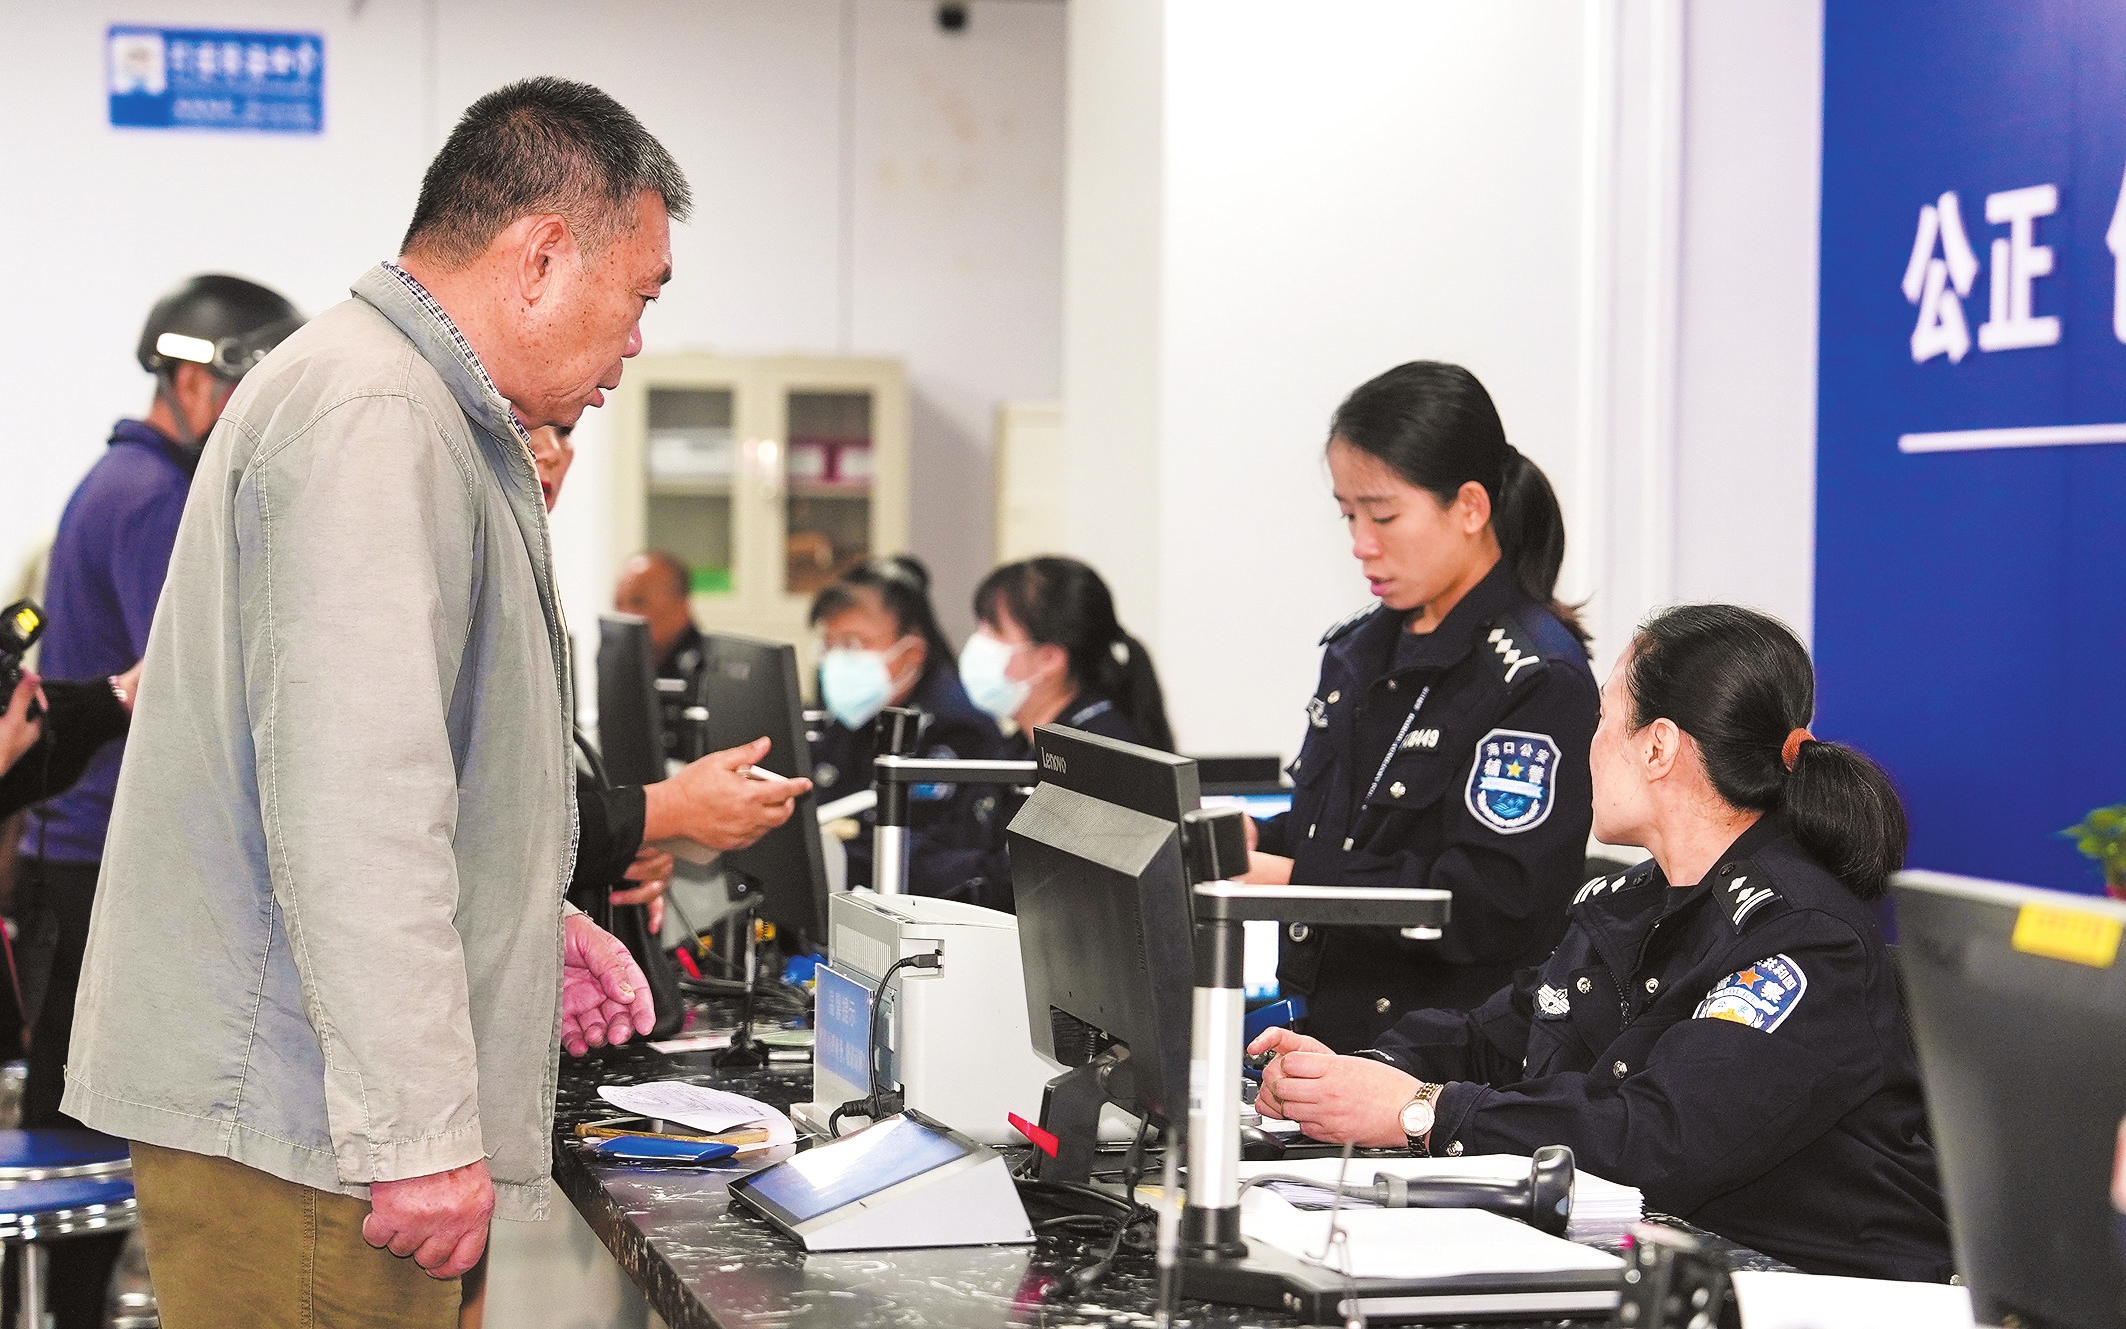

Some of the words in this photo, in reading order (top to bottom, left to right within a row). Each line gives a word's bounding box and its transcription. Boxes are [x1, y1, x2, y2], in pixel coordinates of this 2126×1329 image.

[1902, 183, 2061, 365] 公正
[1041, 747, 1067, 775] Lenovo
[1486, 741, 1550, 765] 海口公安
